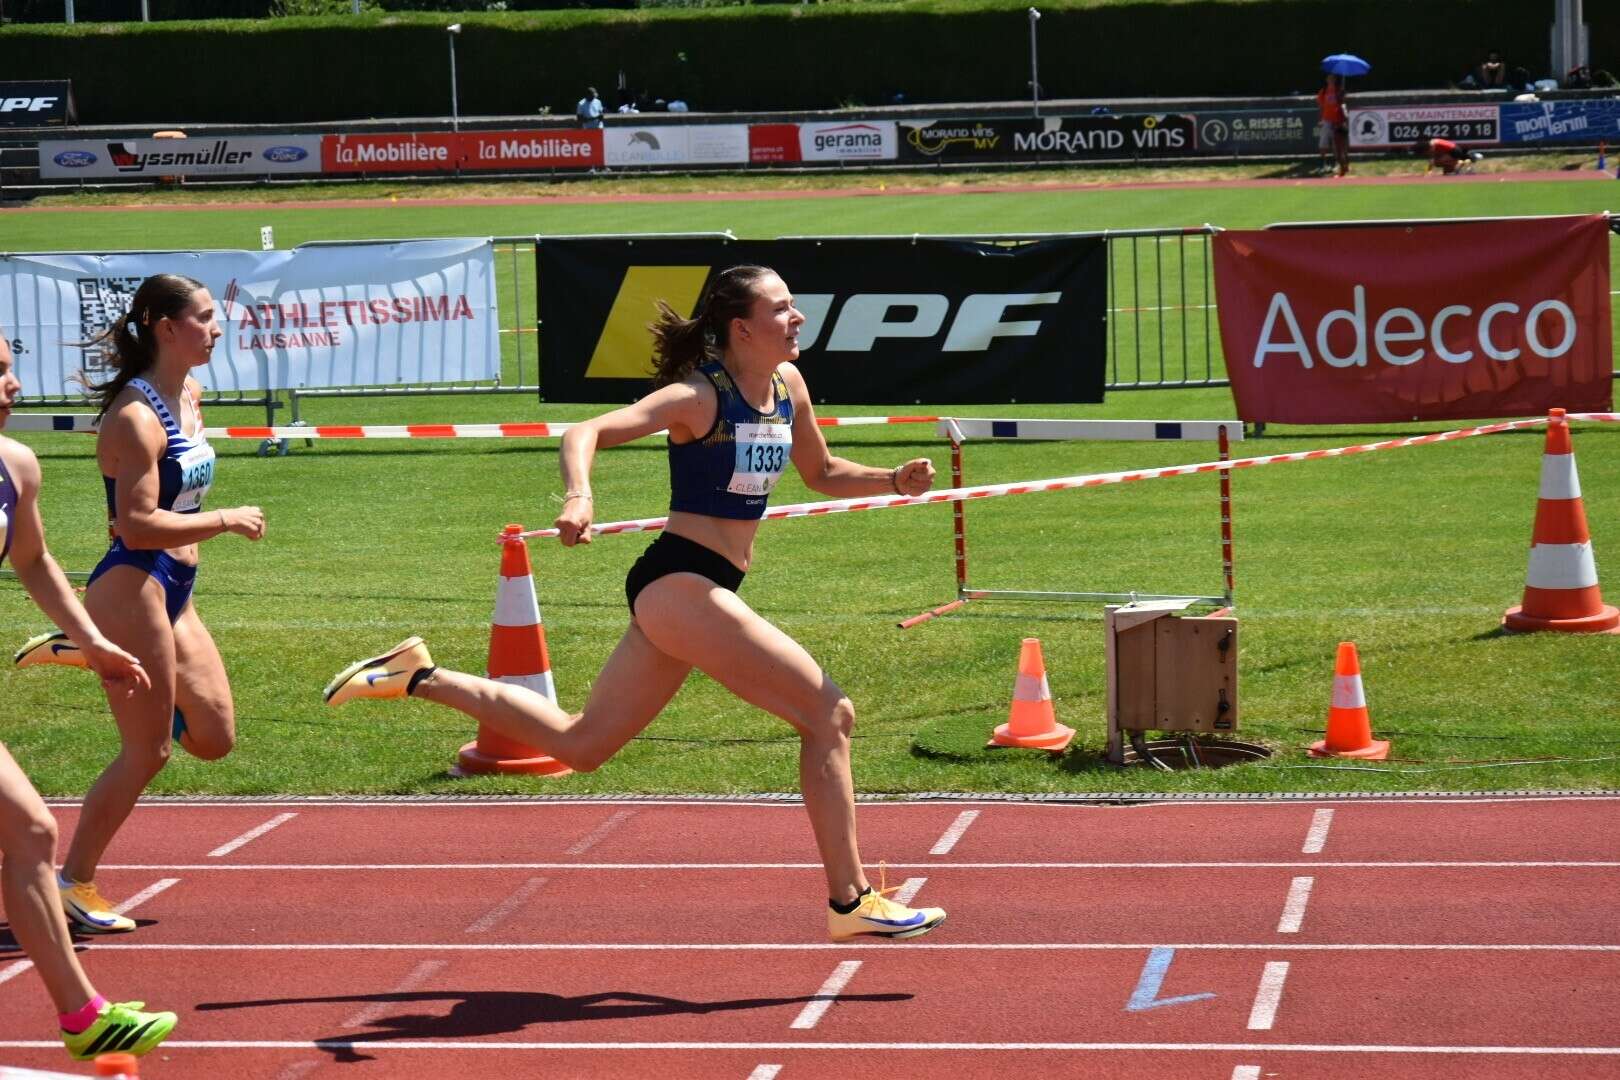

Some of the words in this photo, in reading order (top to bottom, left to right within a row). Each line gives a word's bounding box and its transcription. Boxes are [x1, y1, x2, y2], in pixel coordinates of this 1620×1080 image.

[0, 97, 58, 112] PF
[1232, 118, 1246, 129] G.
[1250, 117, 1283, 129] RISSE
[1287, 117, 1303, 128] SA
[1387, 109, 1498, 121] POLYMAINTENANCE
[922, 128, 969, 139] MORAND
[1232, 129, 1303, 142] MENUISERIE
[1393, 125, 1419, 138] 026
[1423, 124, 1449, 136] 422
[1454, 124, 1471, 136] 19
[1474, 123, 1492, 136] 18
[479, 141, 497, 160] la
[500, 140, 592, 159] Mobilière
[814, 133, 882, 151] gerama
[974, 136, 999, 149] MV
[1013, 129, 1124, 153] MORAND
[336, 144, 353, 162] la
[356, 143, 447, 162] Mobilière
[239, 295, 476, 331] ATHLETISSIMA
[1253, 285, 1577, 369] Adecco
[238, 331, 341, 351] LAUSANNE
[745, 445, 784, 473] 1333
[189, 462, 211, 490] 1360
